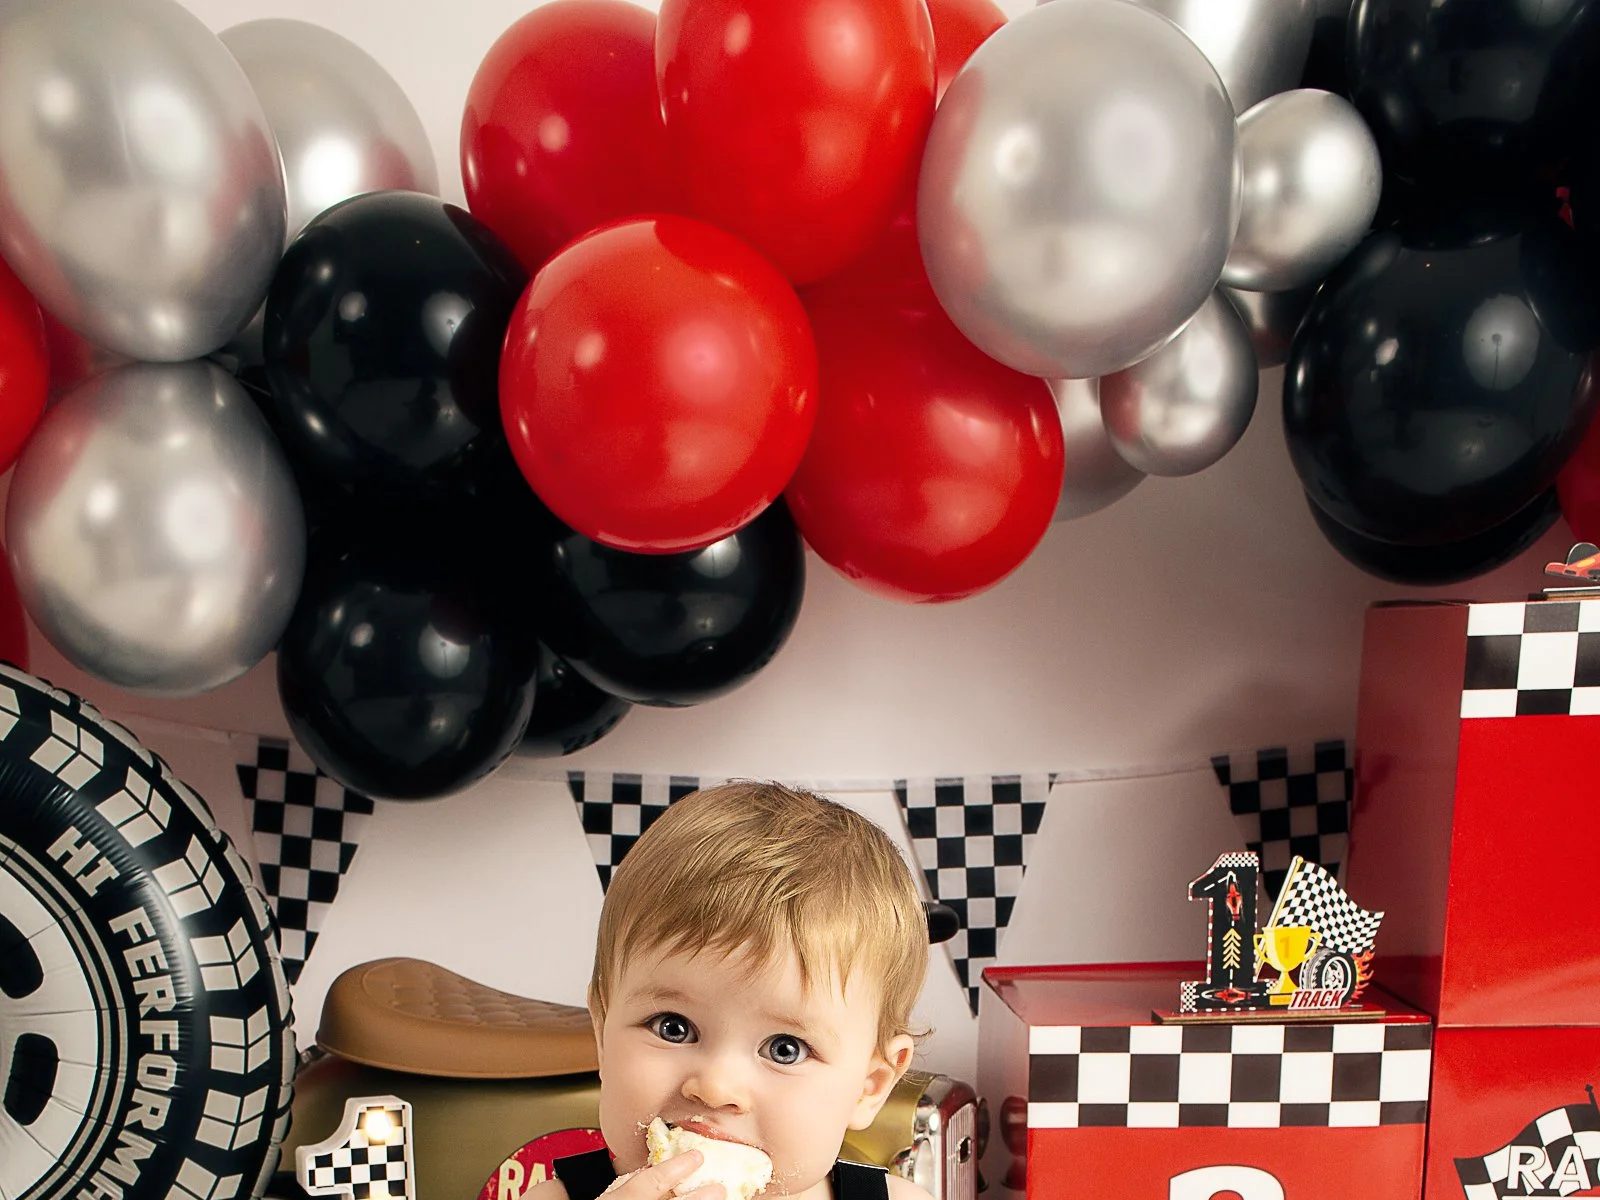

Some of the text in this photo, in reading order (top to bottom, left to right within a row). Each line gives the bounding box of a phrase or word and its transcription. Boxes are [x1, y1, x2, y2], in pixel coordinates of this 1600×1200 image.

[46, 826, 121, 897] HI
[1181, 852, 1277, 1012] 1
[1279, 935, 1291, 959] 1
[1290, 989, 1345, 1008] TRACK
[1506, 1145, 1600, 1191] RA
